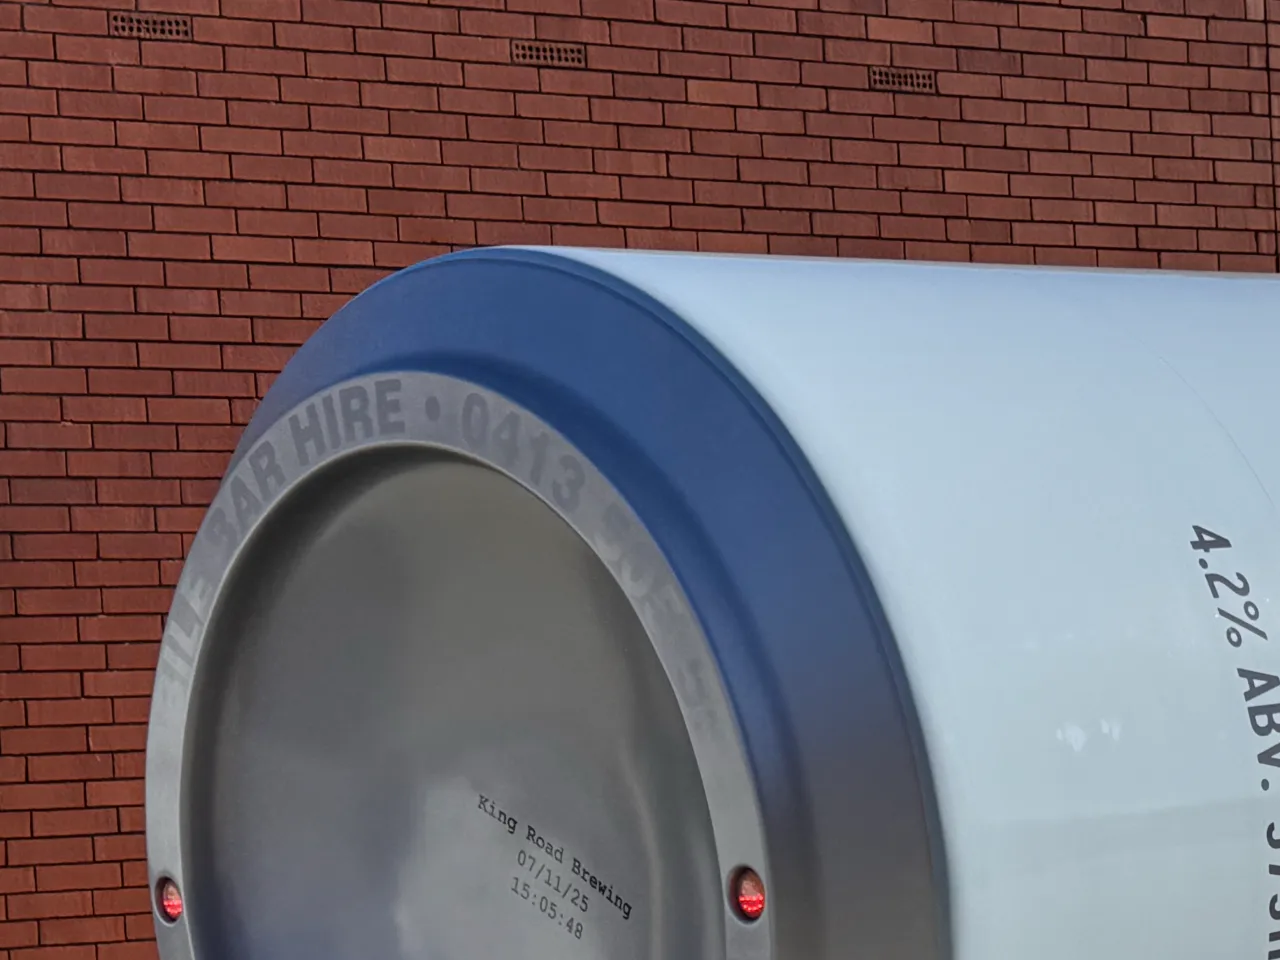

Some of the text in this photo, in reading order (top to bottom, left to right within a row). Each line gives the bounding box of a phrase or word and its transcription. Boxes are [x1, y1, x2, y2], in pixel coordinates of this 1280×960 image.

[208, 438, 288, 552] BAR
[290, 378, 406, 468] HIRE
[460, 391, 588, 511] 0413
[1189, 523, 1269, 649] 4.2%
[477, 793, 633, 920] King Road Brewing
[510, 876, 584, 940] 15:05:48
[517, 849, 589, 913] 07/11/25
